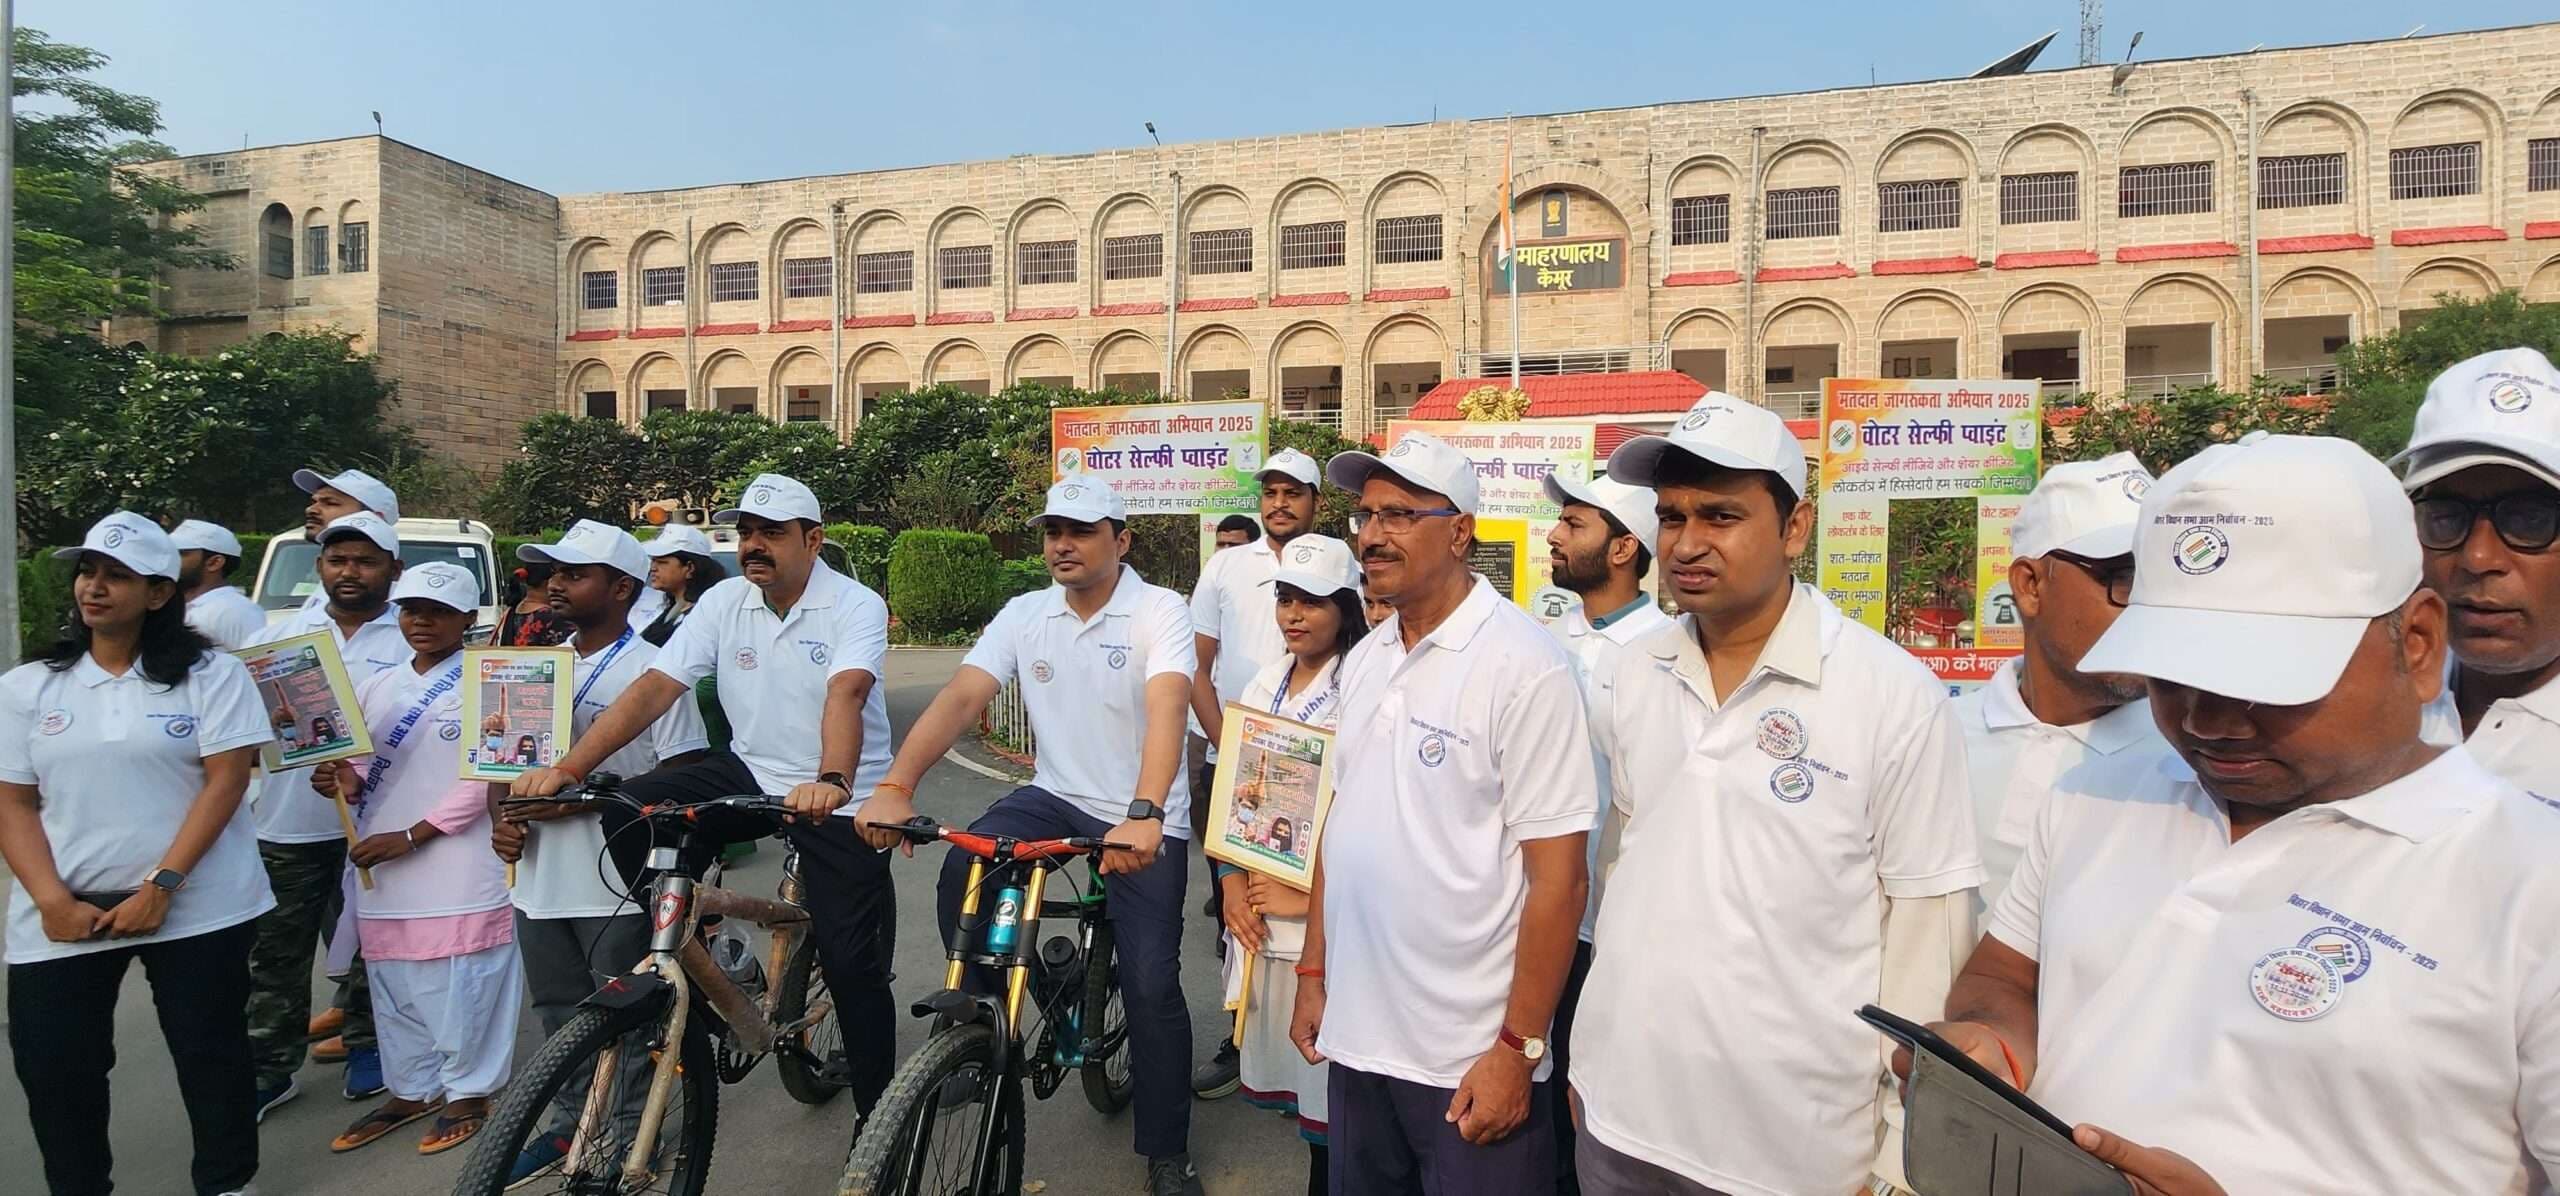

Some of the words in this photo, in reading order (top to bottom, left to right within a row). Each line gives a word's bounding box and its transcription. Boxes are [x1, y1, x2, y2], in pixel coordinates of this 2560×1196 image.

[1516, 241, 1610, 267] माहरणालय
[1537, 267, 1575, 290] कैमूर
[1838, 391, 1878, 409] मतदान
[1947, 388, 1993, 409] अभियान
[1998, 393, 2030, 409] 2025
[1064, 421, 1100, 437] मतदान
[1166, 415, 1213, 434] अभियान
[1219, 416, 1253, 432] 2025
[1862, 419, 1901, 447] वोटर
[1907, 419, 1955, 446] सेल्फी
[1961, 418, 2007, 447] प्वाइंट
[1499, 432, 1545, 449] अभियान
[1549, 436, 1583, 450] 2025
[1086, 445, 1122, 470] वोटर
[1129, 442, 1175, 469] सेल्फी
[1180, 441, 1229, 470] प्वाइंट
[1937, 457, 1955, 470] और
[1958, 456, 1980, 470] शेयर
[1470, 457, 1507, 480] ल्फी
[1159, 480, 1177, 492] और
[1179, 479, 1201, 491] शेयर
[1832, 478, 1875, 494] लोकतंत्र
[1877, 477, 1887, 491] में
[1936, 478, 1951, 491] हम
[1158, 498, 1172, 509] हम
[1176, 496, 1208, 509] सबकी
[1487, 504, 1503, 514] हम
[1840, 571, 1870, 583] मतदान
[1952, 652, 1978, 673] करें
[1978, 656, 2006, 673] मत
[2411, 952, 2440, 971] 2025
